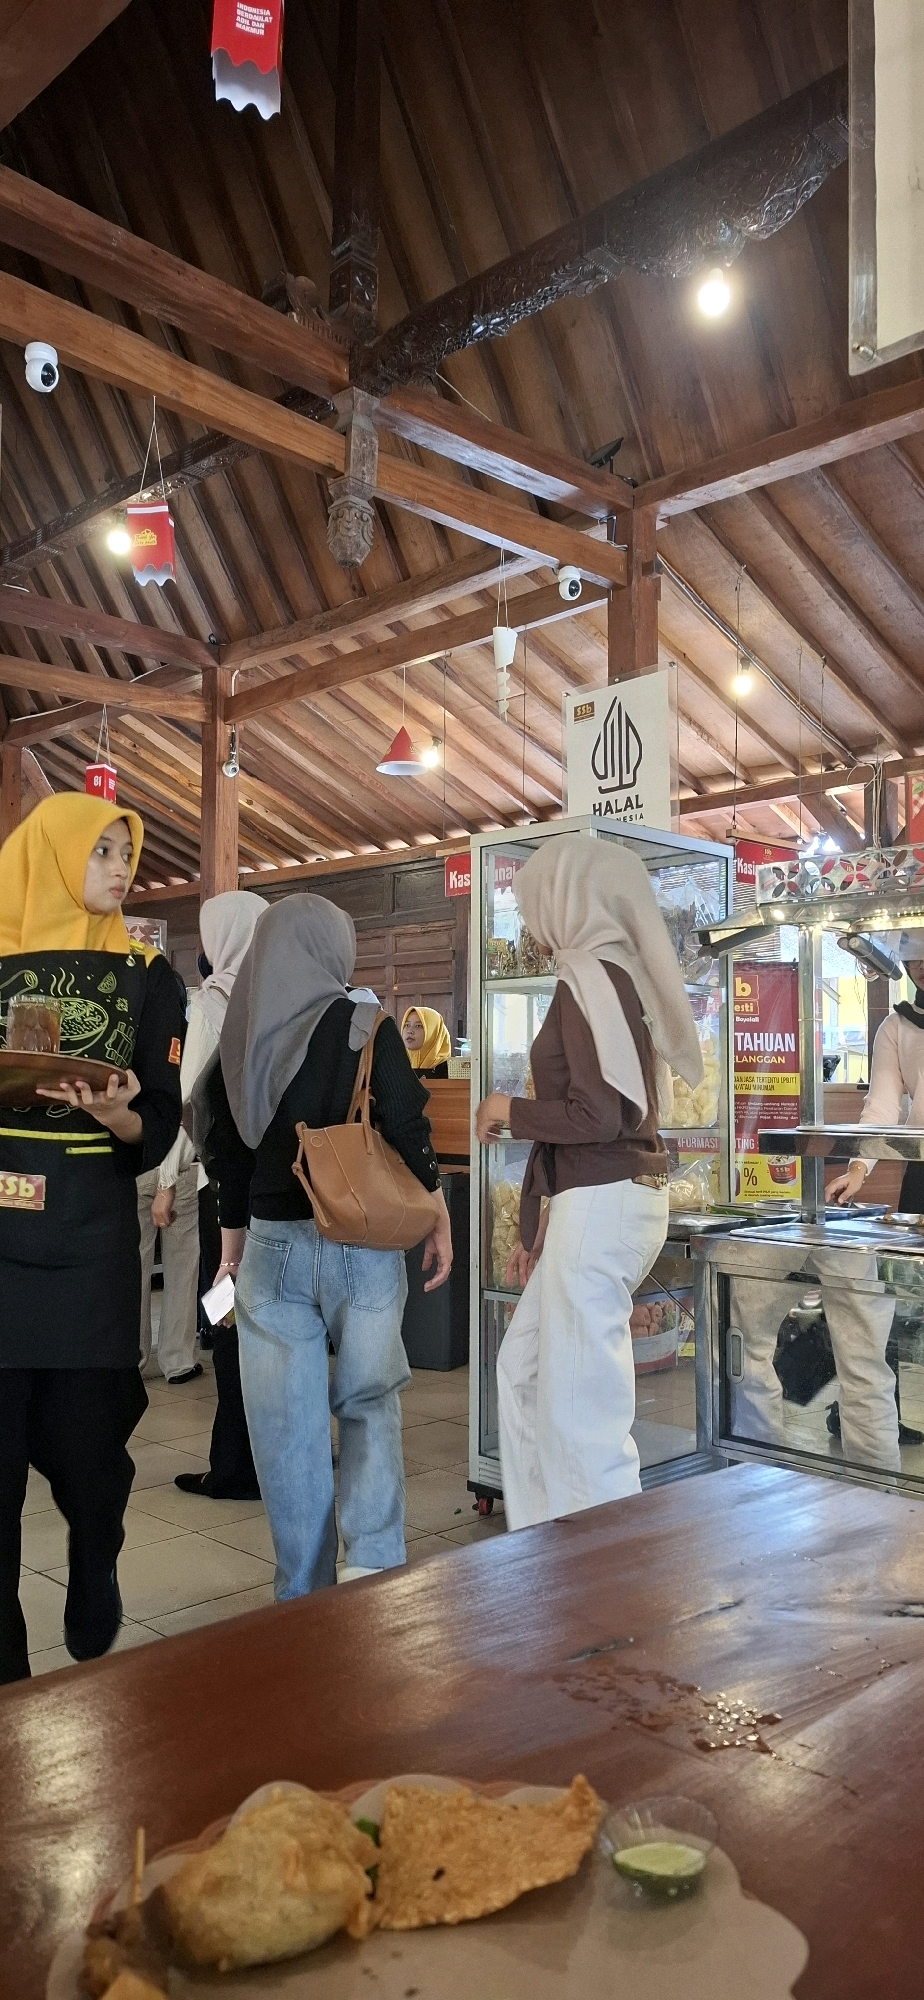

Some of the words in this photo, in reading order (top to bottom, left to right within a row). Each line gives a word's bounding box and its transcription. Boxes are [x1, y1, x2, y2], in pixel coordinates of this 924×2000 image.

[236, 2, 271, 16] INDONESIA
[236, 9, 273, 23] BERDAULAT
[235, 22, 265, 35] MAKMUR
[236, 16, 250, 25] ADIL
[251, 21, 265, 29] DAN
[592, 794, 644, 817] HALAL
[737, 858, 755, 876] Kasi
[449, 871, 471, 889] Kas
[734, 1055, 786, 1064] LANGGAN
[735, 1138, 755, 1150] TING
[0, 1175, 36, 1198] sb
